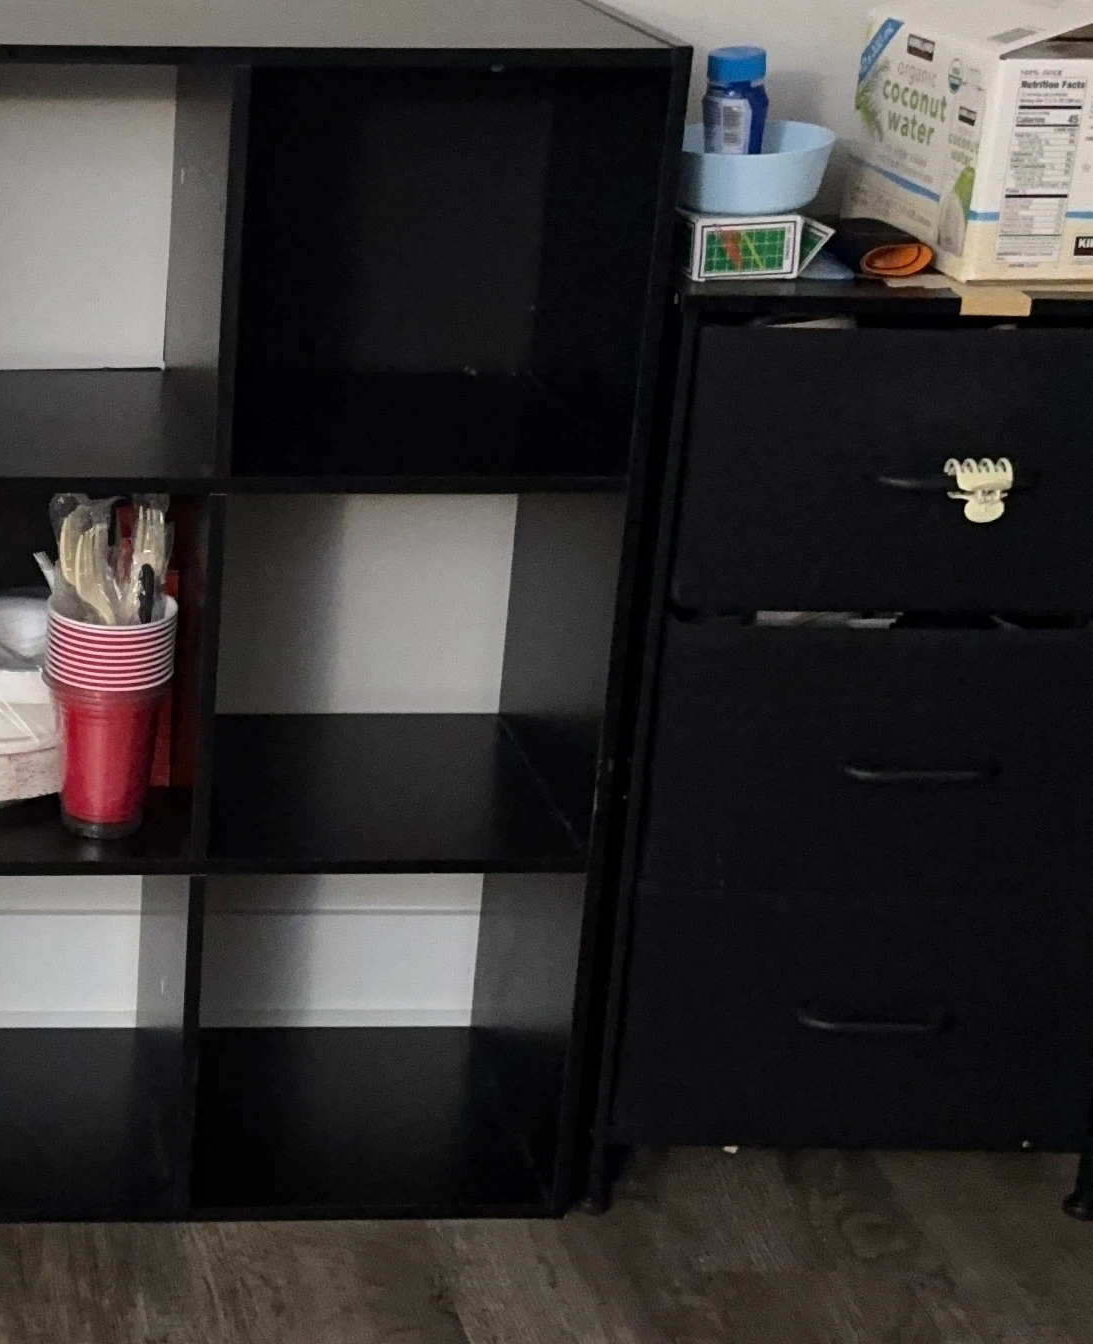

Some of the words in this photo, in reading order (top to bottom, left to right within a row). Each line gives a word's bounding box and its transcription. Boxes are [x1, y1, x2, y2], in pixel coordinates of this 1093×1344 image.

[883, 79, 948, 123] coconut
[1021, 80, 1059, 89] Nutrition
[1062, 80, 1085, 89] Facts
[888, 110, 935, 146] water
